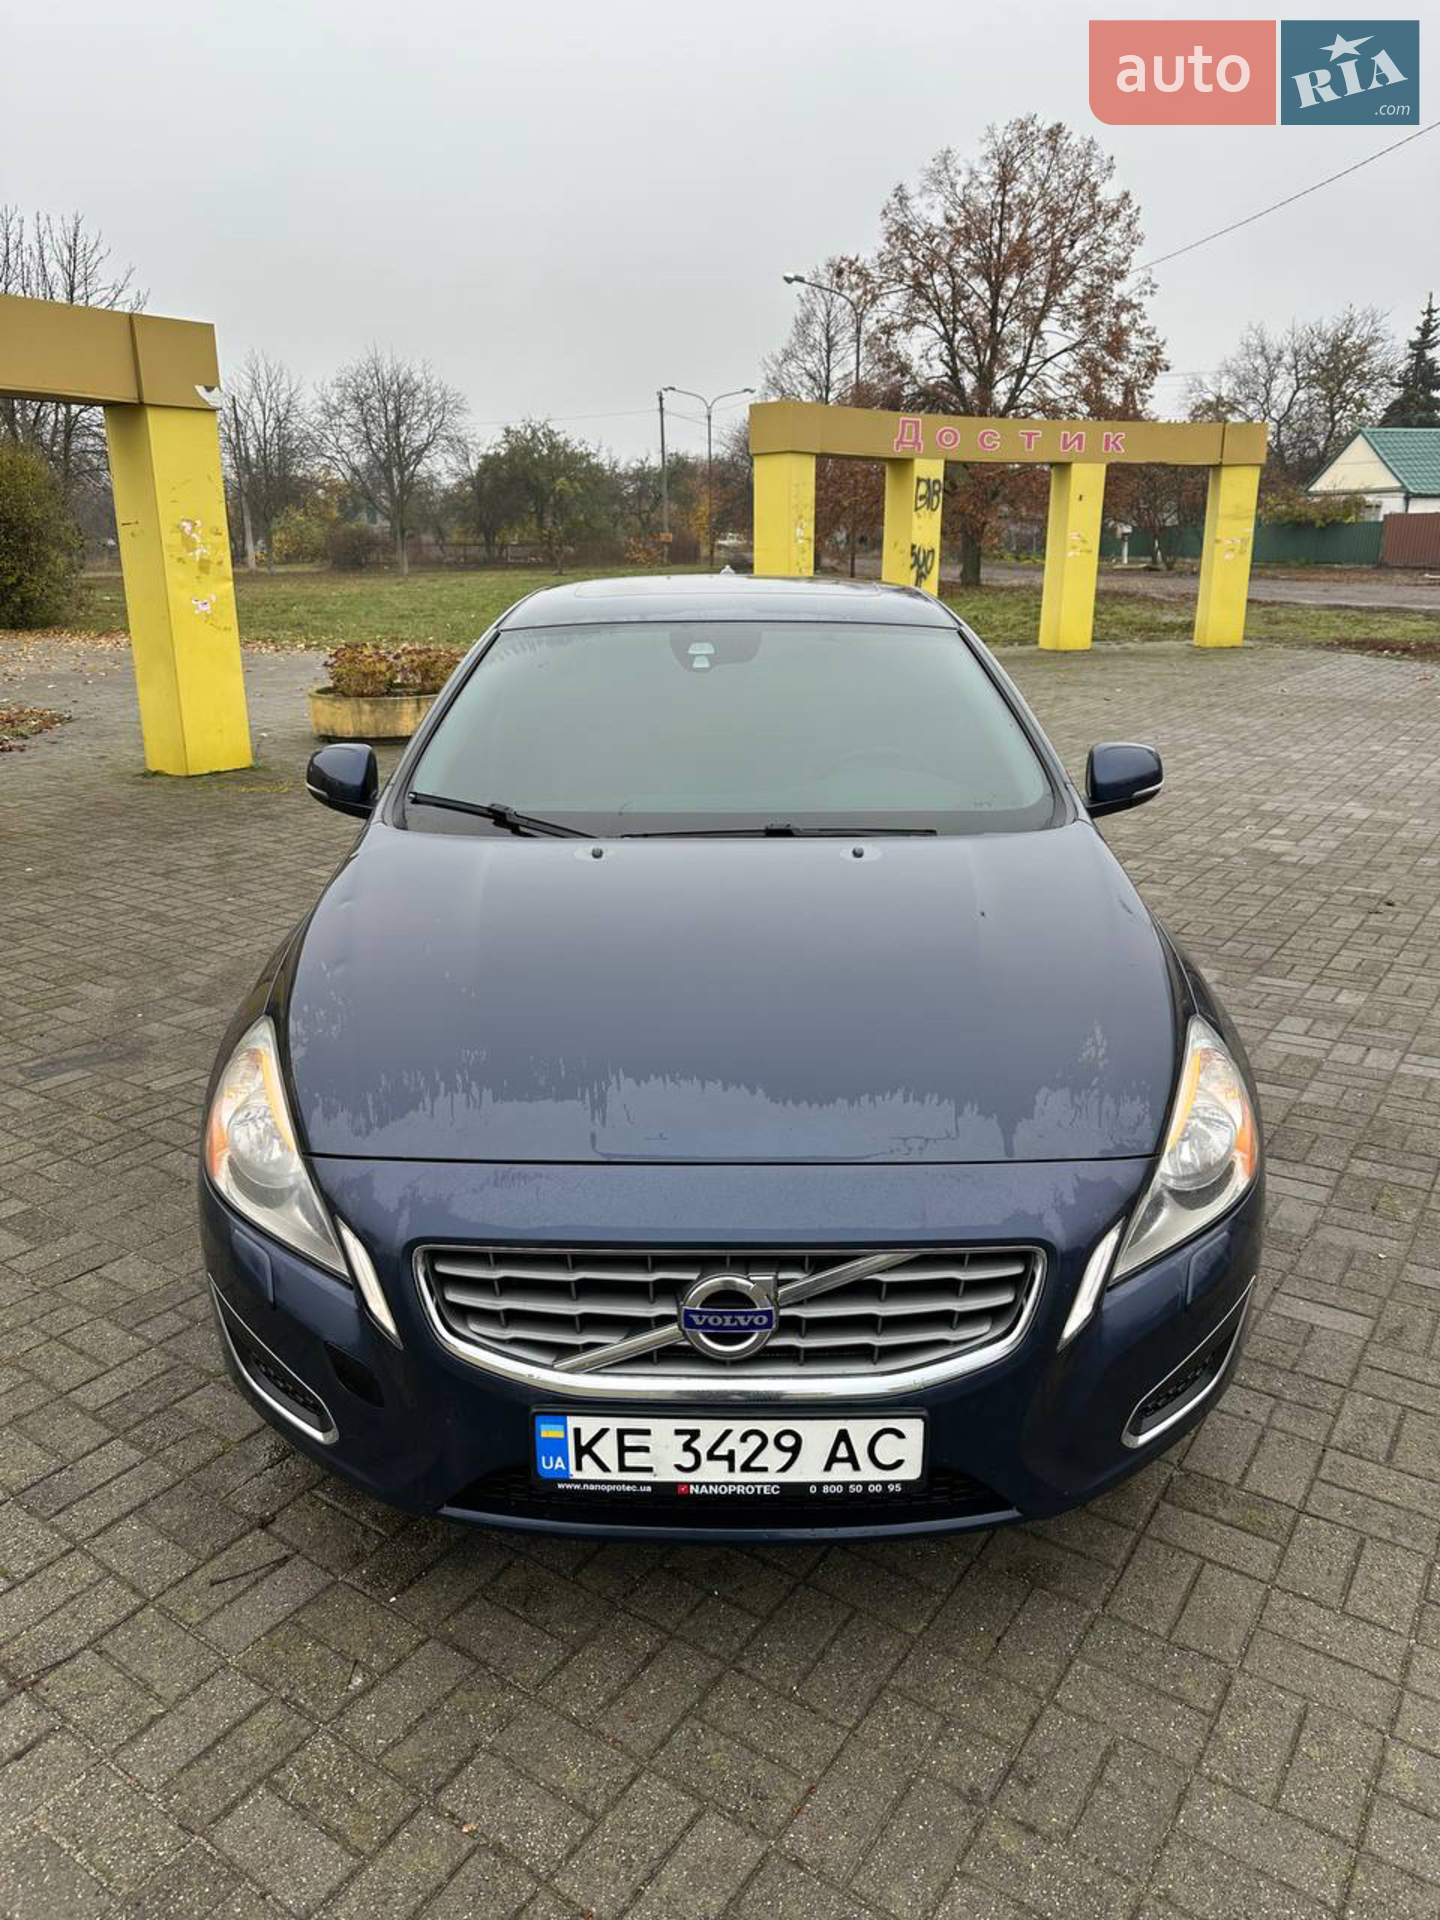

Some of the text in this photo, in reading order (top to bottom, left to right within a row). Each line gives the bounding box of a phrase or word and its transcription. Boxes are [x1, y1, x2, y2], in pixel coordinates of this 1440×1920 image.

[689, 1314, 769, 1327] VOLVO
[572, 1426, 907, 1474] KE 3429 AC
[541, 1455, 566, 1470] UA
[557, 1481, 652, 1494] www.nanoprotec.ua
[689, 1484, 781, 1496] NANOPROTEC
[809, 1483, 902, 1494] 0 800 50 00 95
